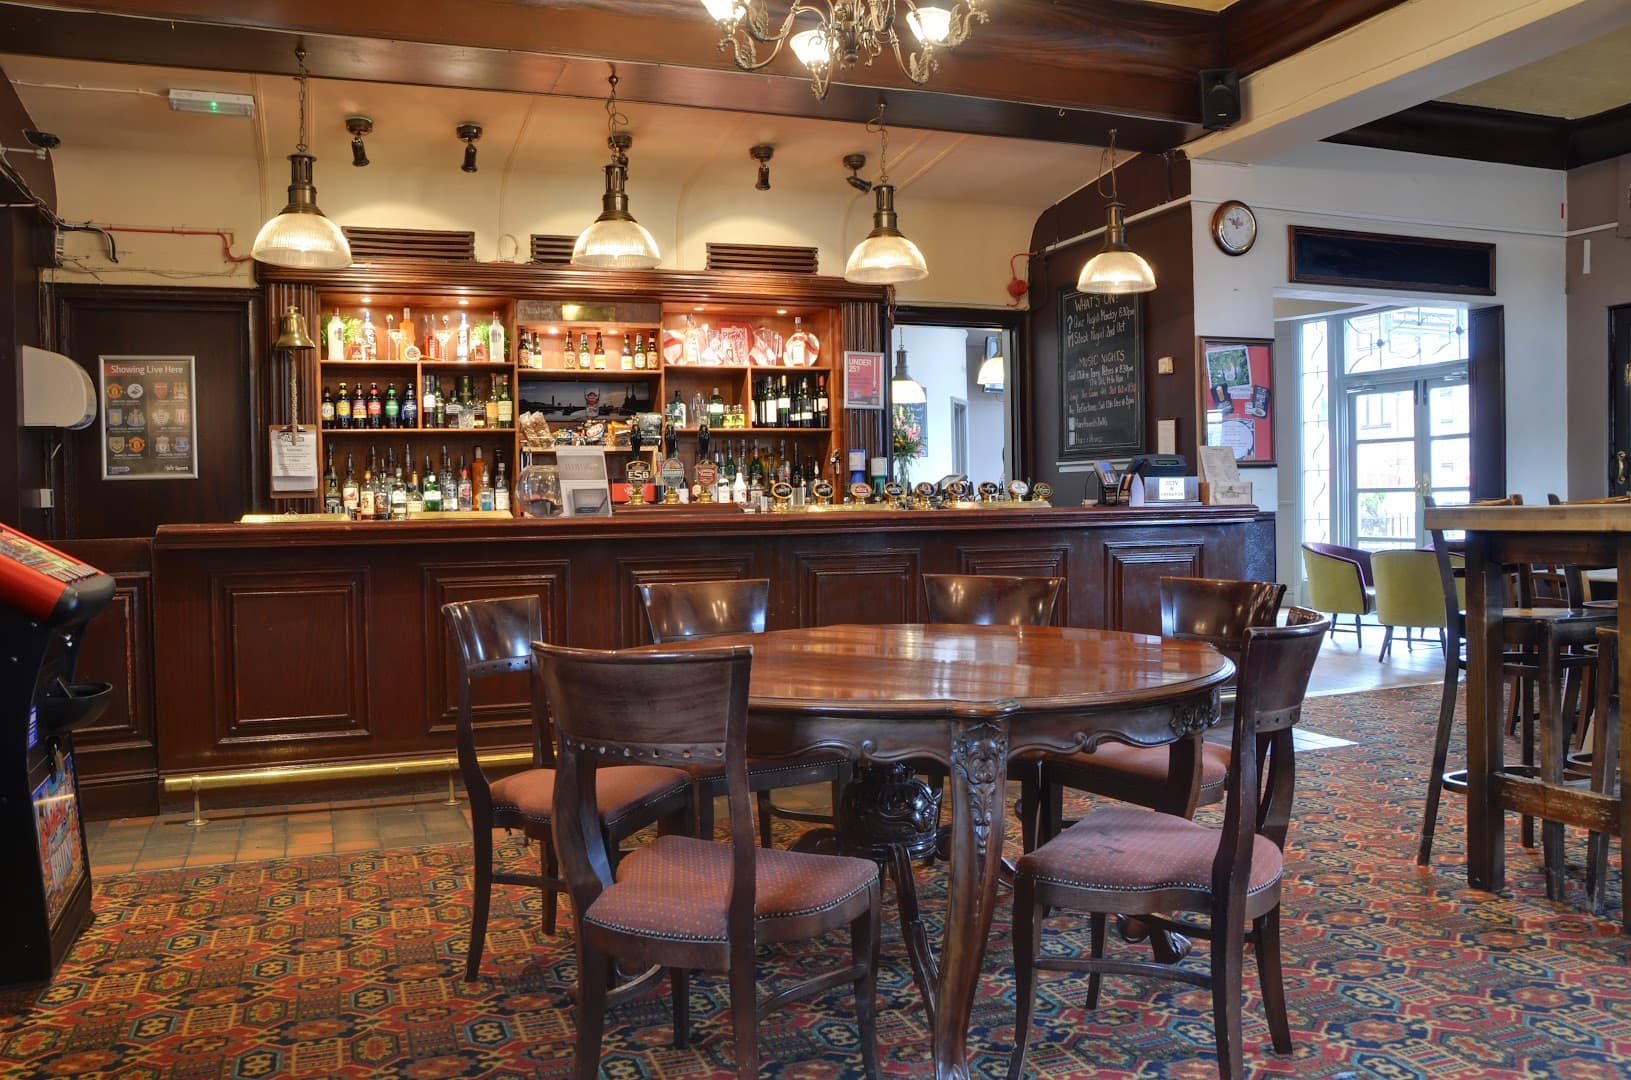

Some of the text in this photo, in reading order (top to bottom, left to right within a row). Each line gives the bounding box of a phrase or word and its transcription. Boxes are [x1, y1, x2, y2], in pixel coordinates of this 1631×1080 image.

[111, 365, 184, 375] Showing Live Here
[628, 470, 649, 480] ESB
